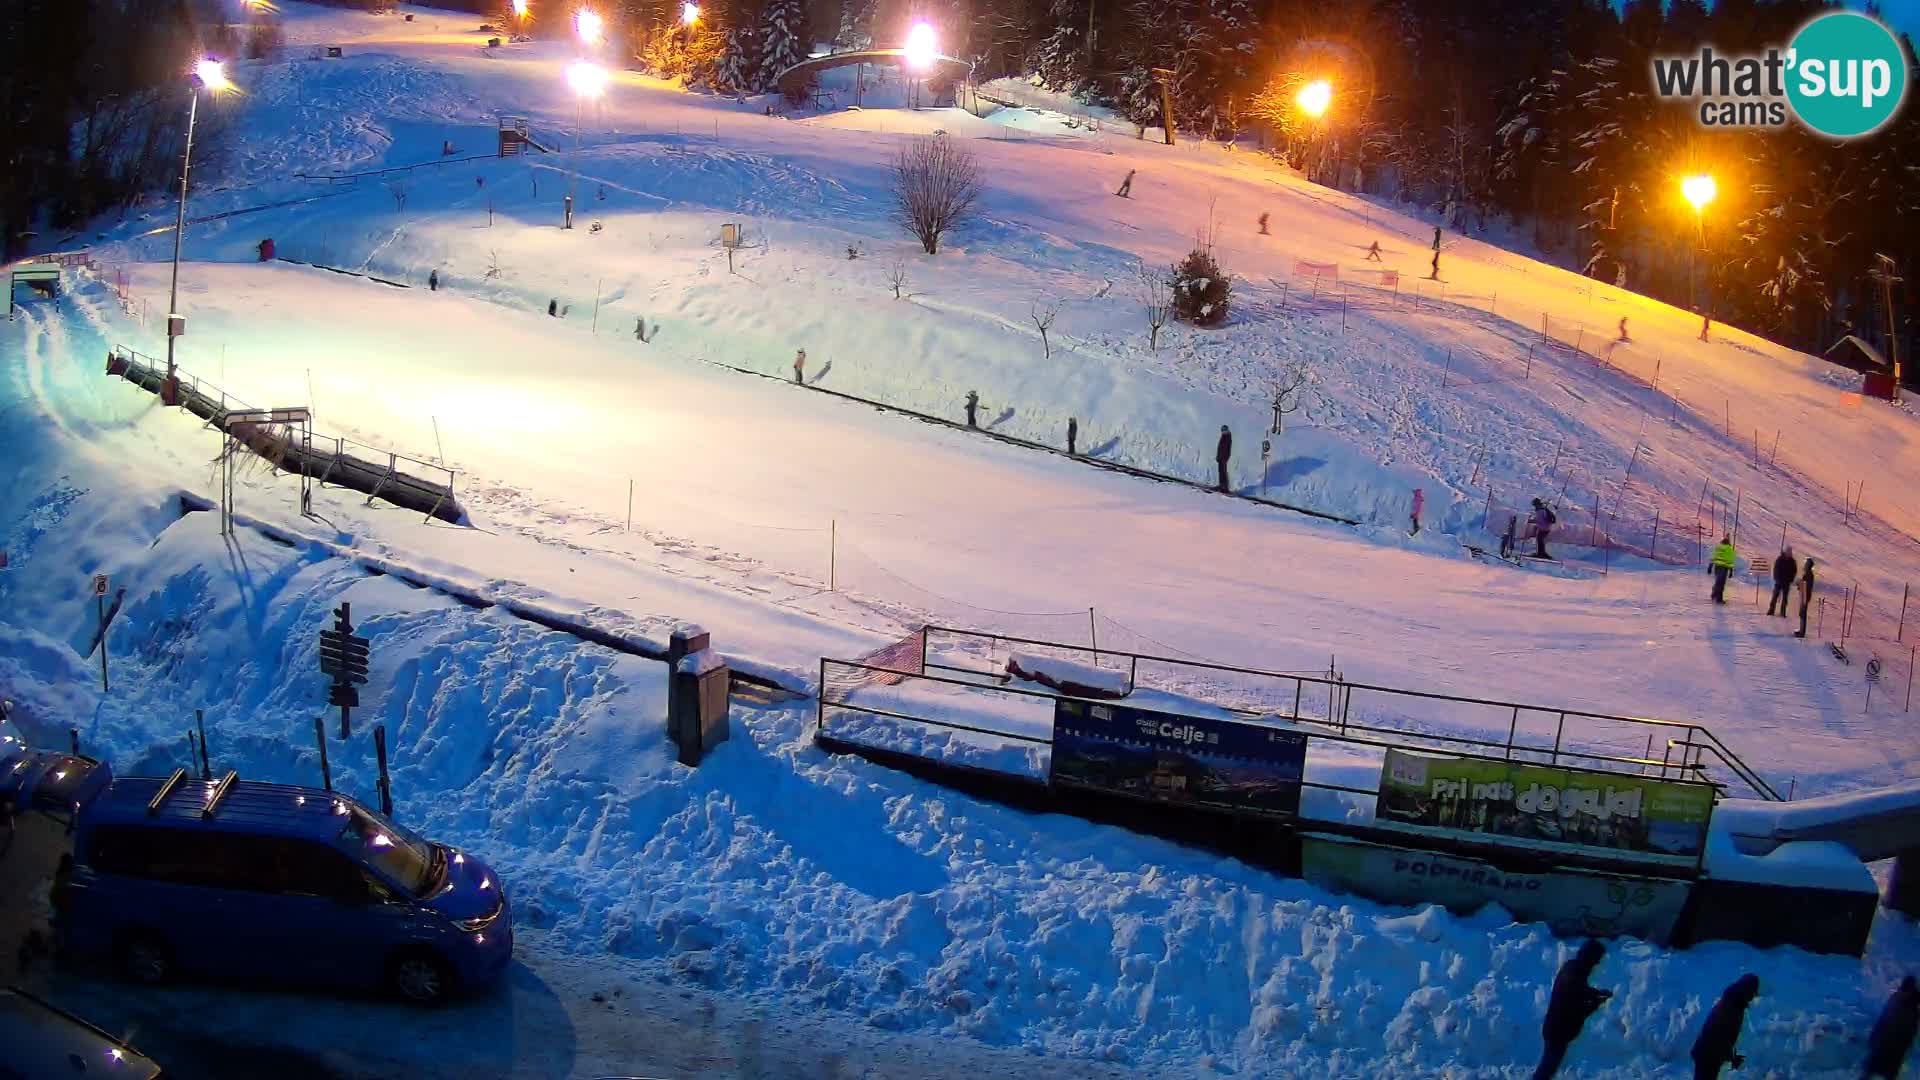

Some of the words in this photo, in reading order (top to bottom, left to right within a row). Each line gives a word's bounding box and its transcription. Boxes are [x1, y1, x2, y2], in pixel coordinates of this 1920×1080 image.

[1159, 723, 1205, 745] Celje
[1431, 777, 1468, 800] Pri
[1472, 781, 1514, 801] nas
